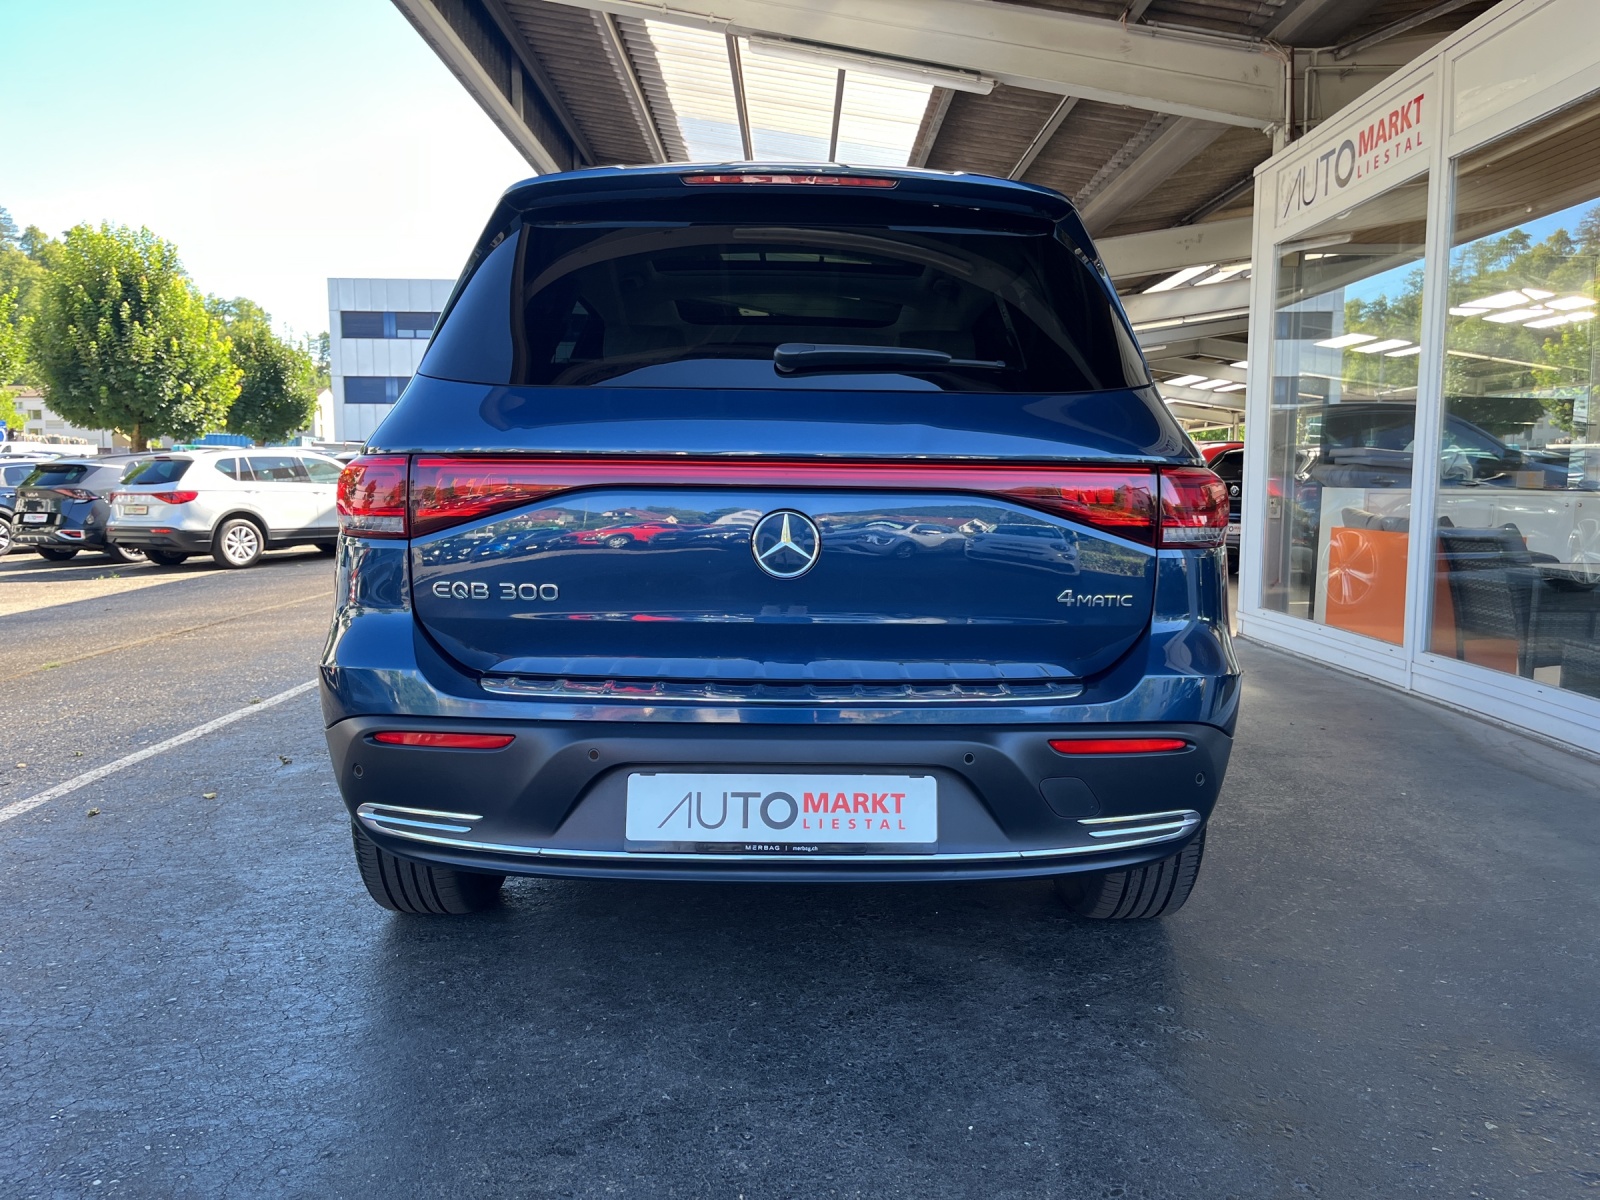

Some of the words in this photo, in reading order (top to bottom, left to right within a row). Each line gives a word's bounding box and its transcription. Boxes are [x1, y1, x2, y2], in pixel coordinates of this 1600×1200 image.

[1283, 139, 1356, 218] AUTO
[1358, 93, 1424, 158] MARKT
[1357, 131, 1423, 179] LIESTAL
[432, 581, 489, 600] EQB
[499, 582, 559, 601] 300
[1057, 589, 1133, 607] 4MATIC
[657, 791, 799, 830] AUTO
[803, 792, 906, 814] MARKT
[803, 818, 906, 830] LIESTAL
